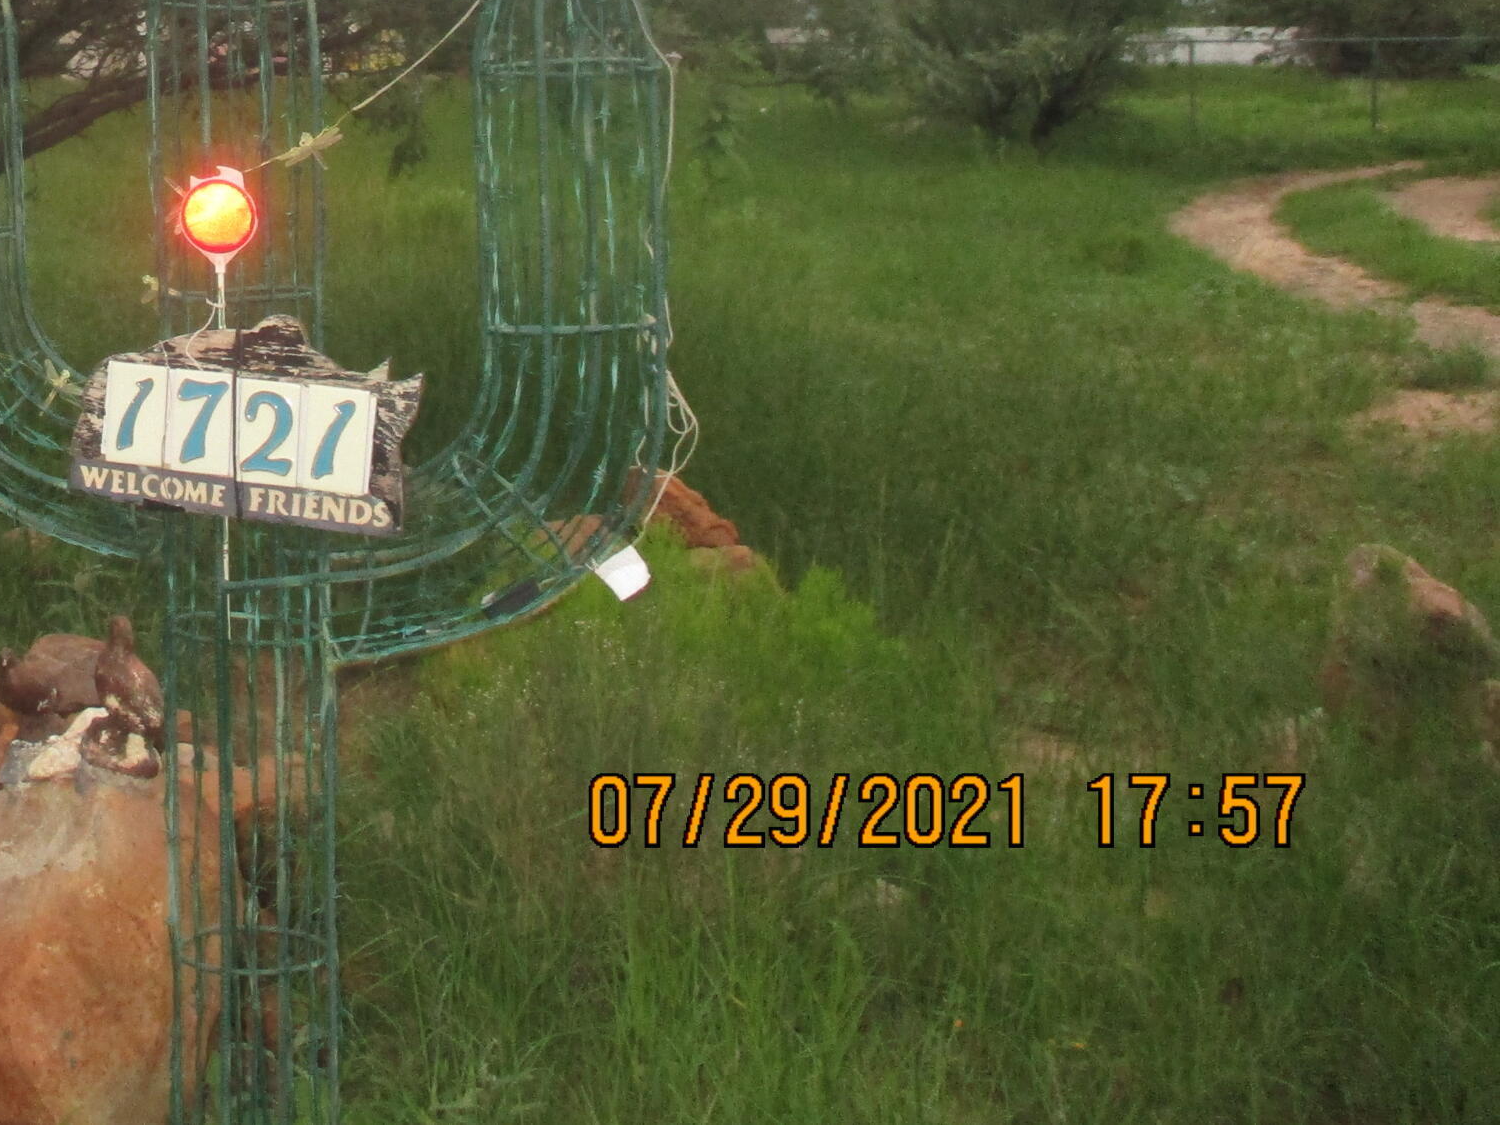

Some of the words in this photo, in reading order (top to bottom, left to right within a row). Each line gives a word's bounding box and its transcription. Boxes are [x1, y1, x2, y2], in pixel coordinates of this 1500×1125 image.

[115, 377, 357, 480] 1721
[79, 464, 226, 507] WELCOME
[248, 487, 393, 528] FRIENDS
